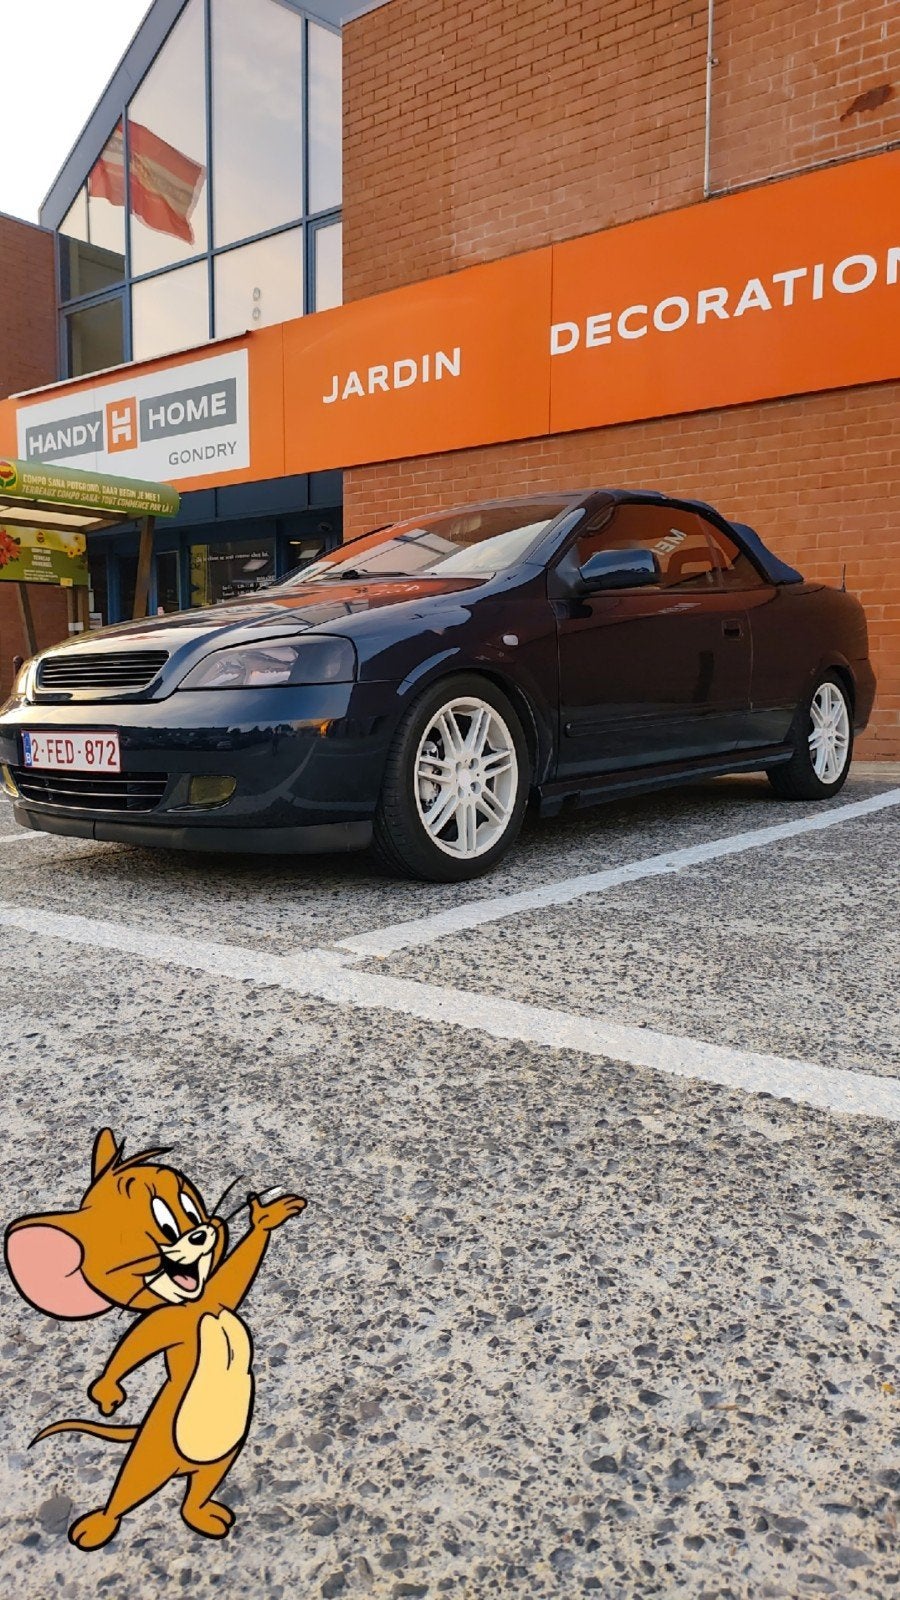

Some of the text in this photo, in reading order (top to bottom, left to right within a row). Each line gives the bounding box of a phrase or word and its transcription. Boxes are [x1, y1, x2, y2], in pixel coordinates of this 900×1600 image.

[323, 347, 461, 404] JARDIN
[29, 421, 101, 456] HANDY
[148, 391, 227, 430] HOME
[168, 441, 238, 466] GONDRY
[22, 485, 56, 496] TERREAUX
[57, 489, 81, 500] COMPO
[101, 495, 118, 506] TOUT
[118, 498, 150, 509] COMMENCE
[150, 503, 162, 512] PAR
[23, 474, 47, 485] COMPO
[48, 477, 65, 488] SANA
[102, 485, 118, 496] DAAR
[119, 487, 137, 498] BEGIN
